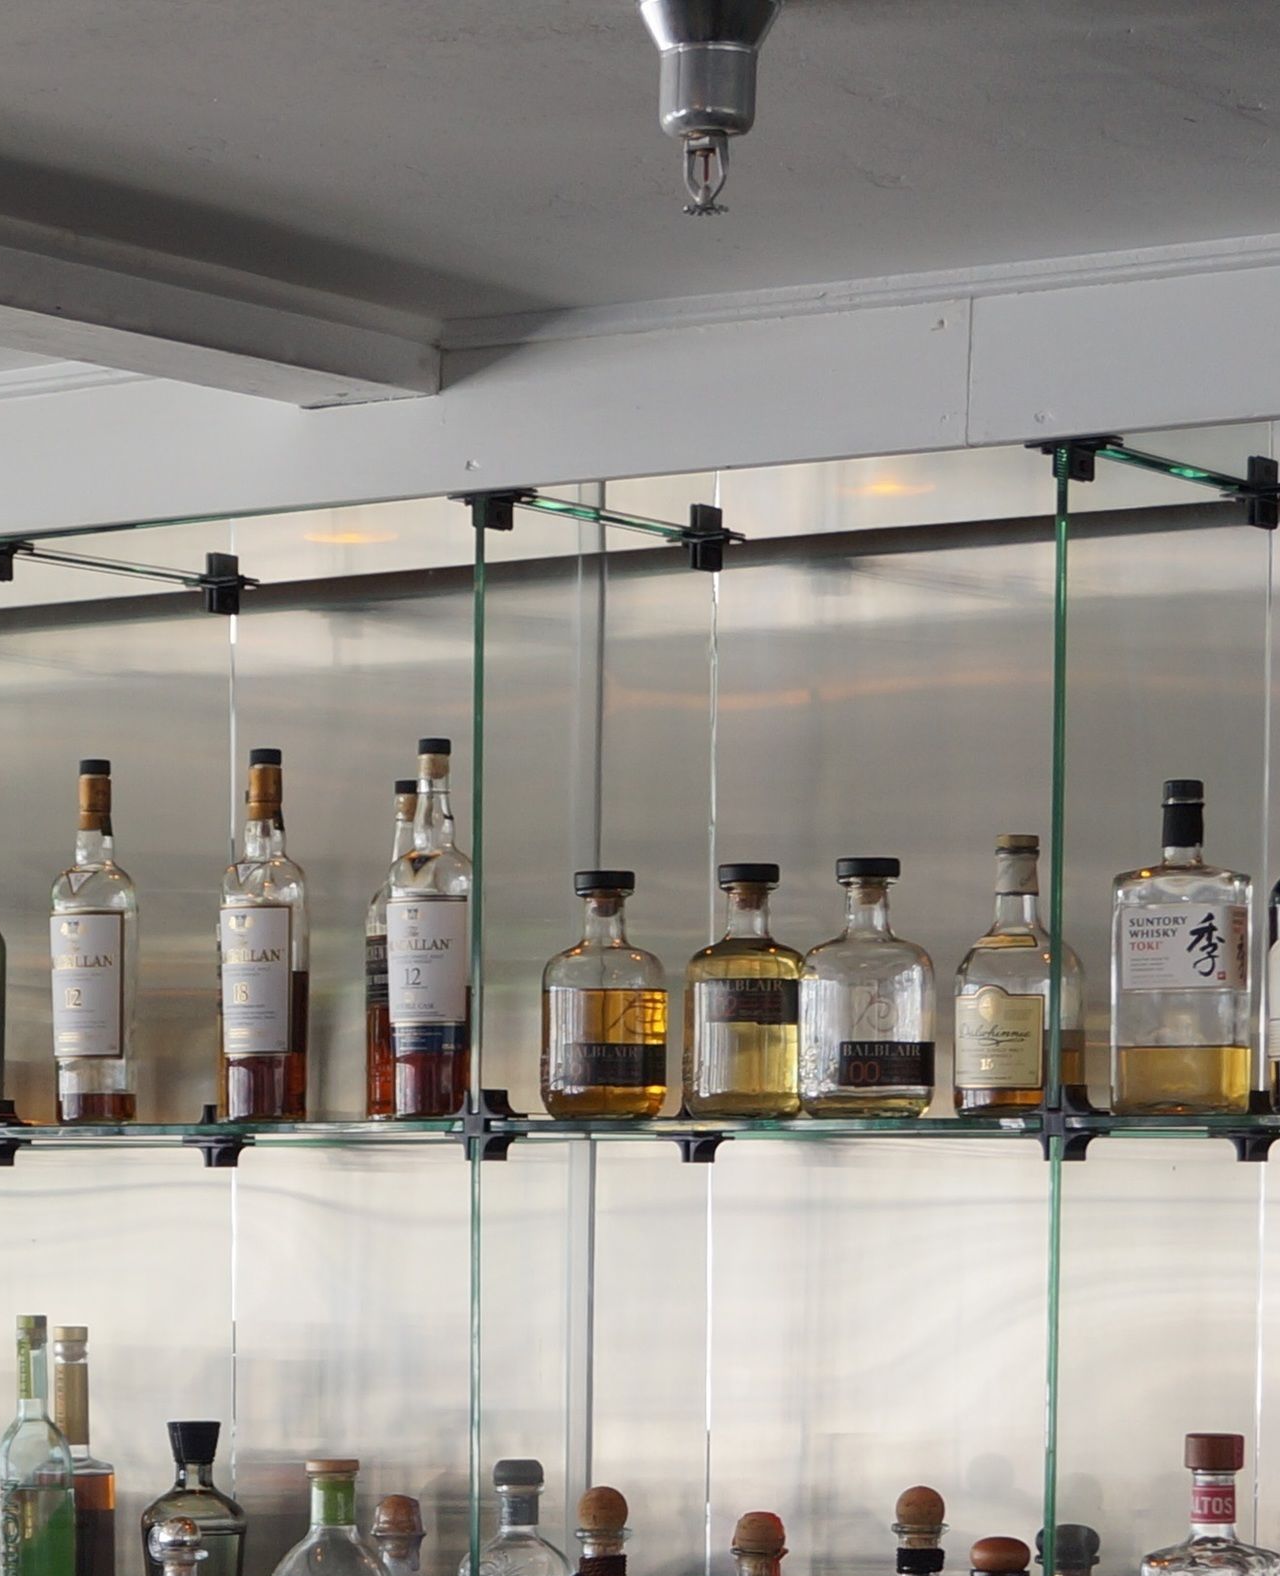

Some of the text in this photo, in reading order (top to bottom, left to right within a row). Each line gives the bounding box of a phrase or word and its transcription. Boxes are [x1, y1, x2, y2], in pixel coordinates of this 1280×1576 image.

[1128, 915, 1188, 928] SUNTORY
[1128, 928, 1178, 939] WHISKY
[1129, 941, 1160, 952] TOKI
[405, 967, 422, 986] 12
[843, 1044, 922, 1058] BALBLAIR
